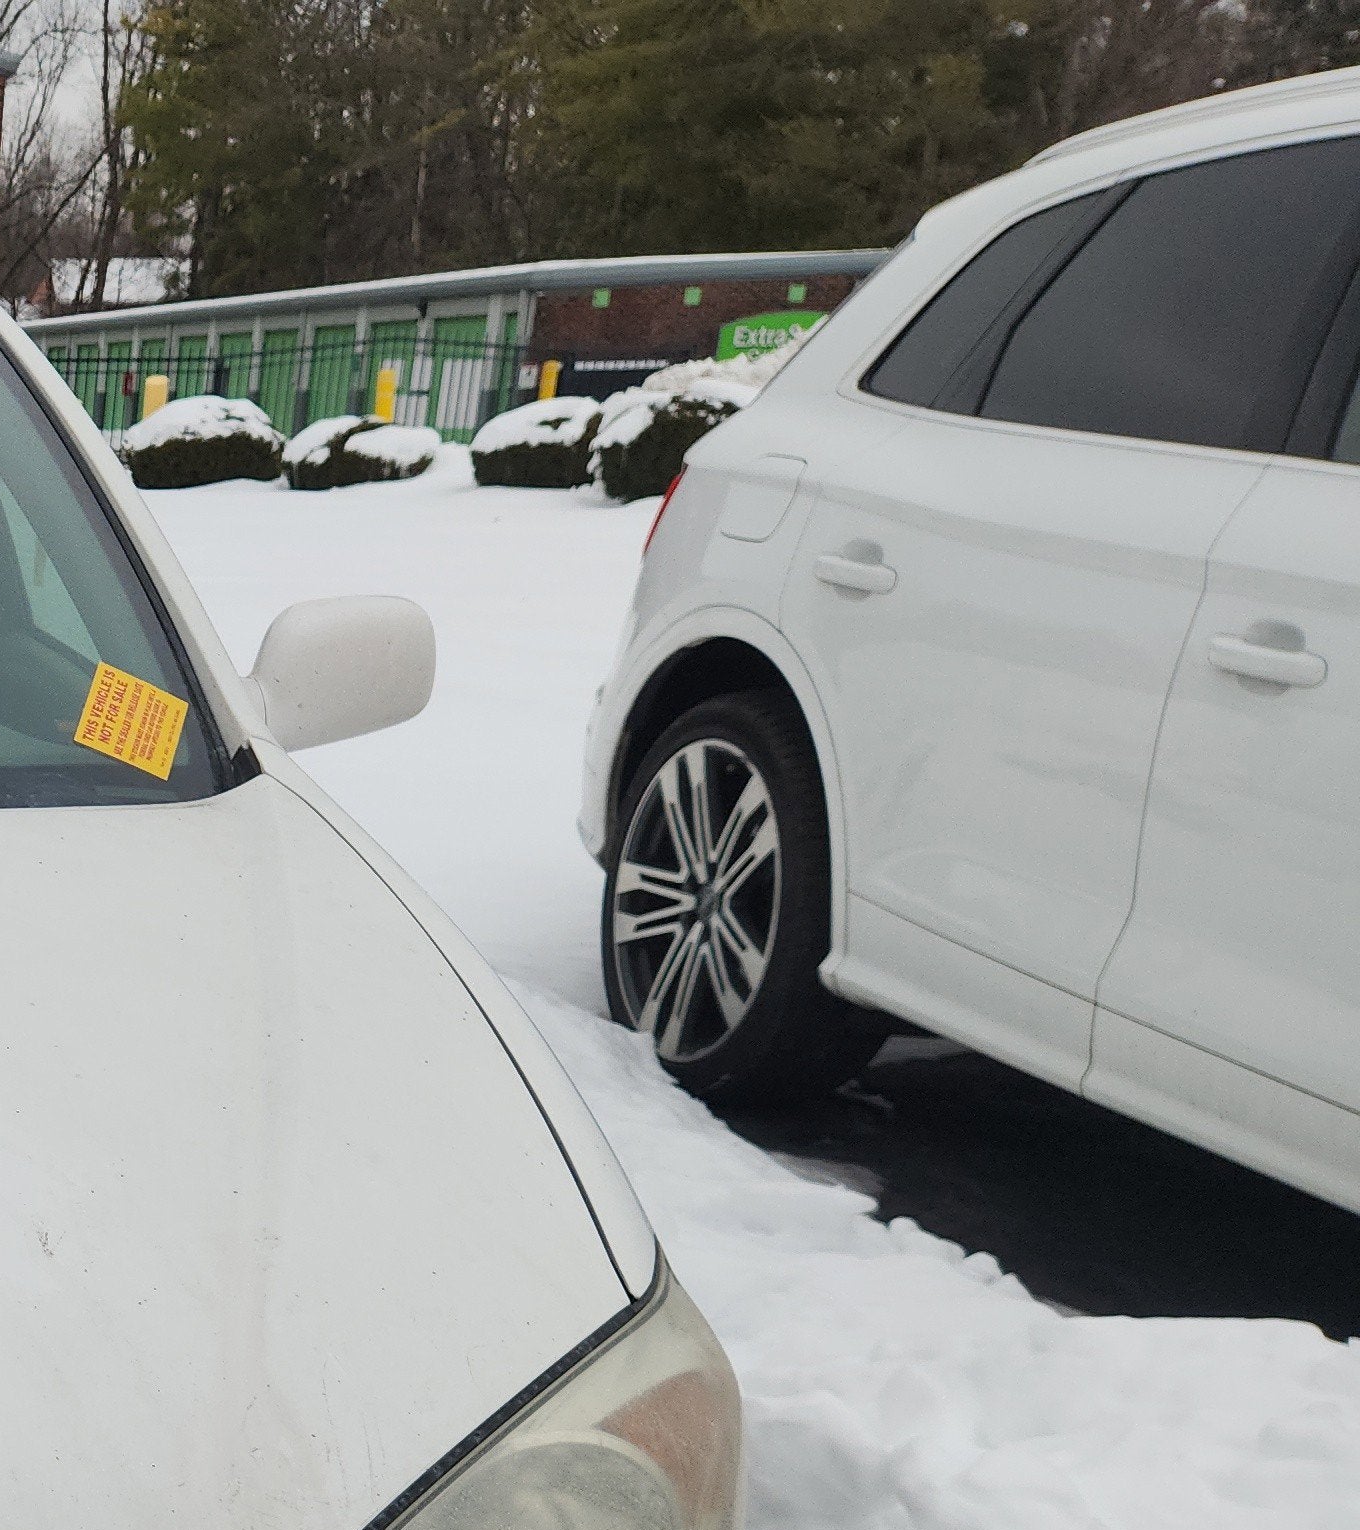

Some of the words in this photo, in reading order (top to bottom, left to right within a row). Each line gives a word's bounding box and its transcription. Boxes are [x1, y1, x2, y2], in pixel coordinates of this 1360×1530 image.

[103, 669, 116, 680] IS
[90, 679, 112, 719] VEHICLE
[111, 680, 128, 704] SALE
[104, 703, 120, 723] FOR
[82, 718, 99, 742] THIS
[98, 723, 114, 745] NOT
